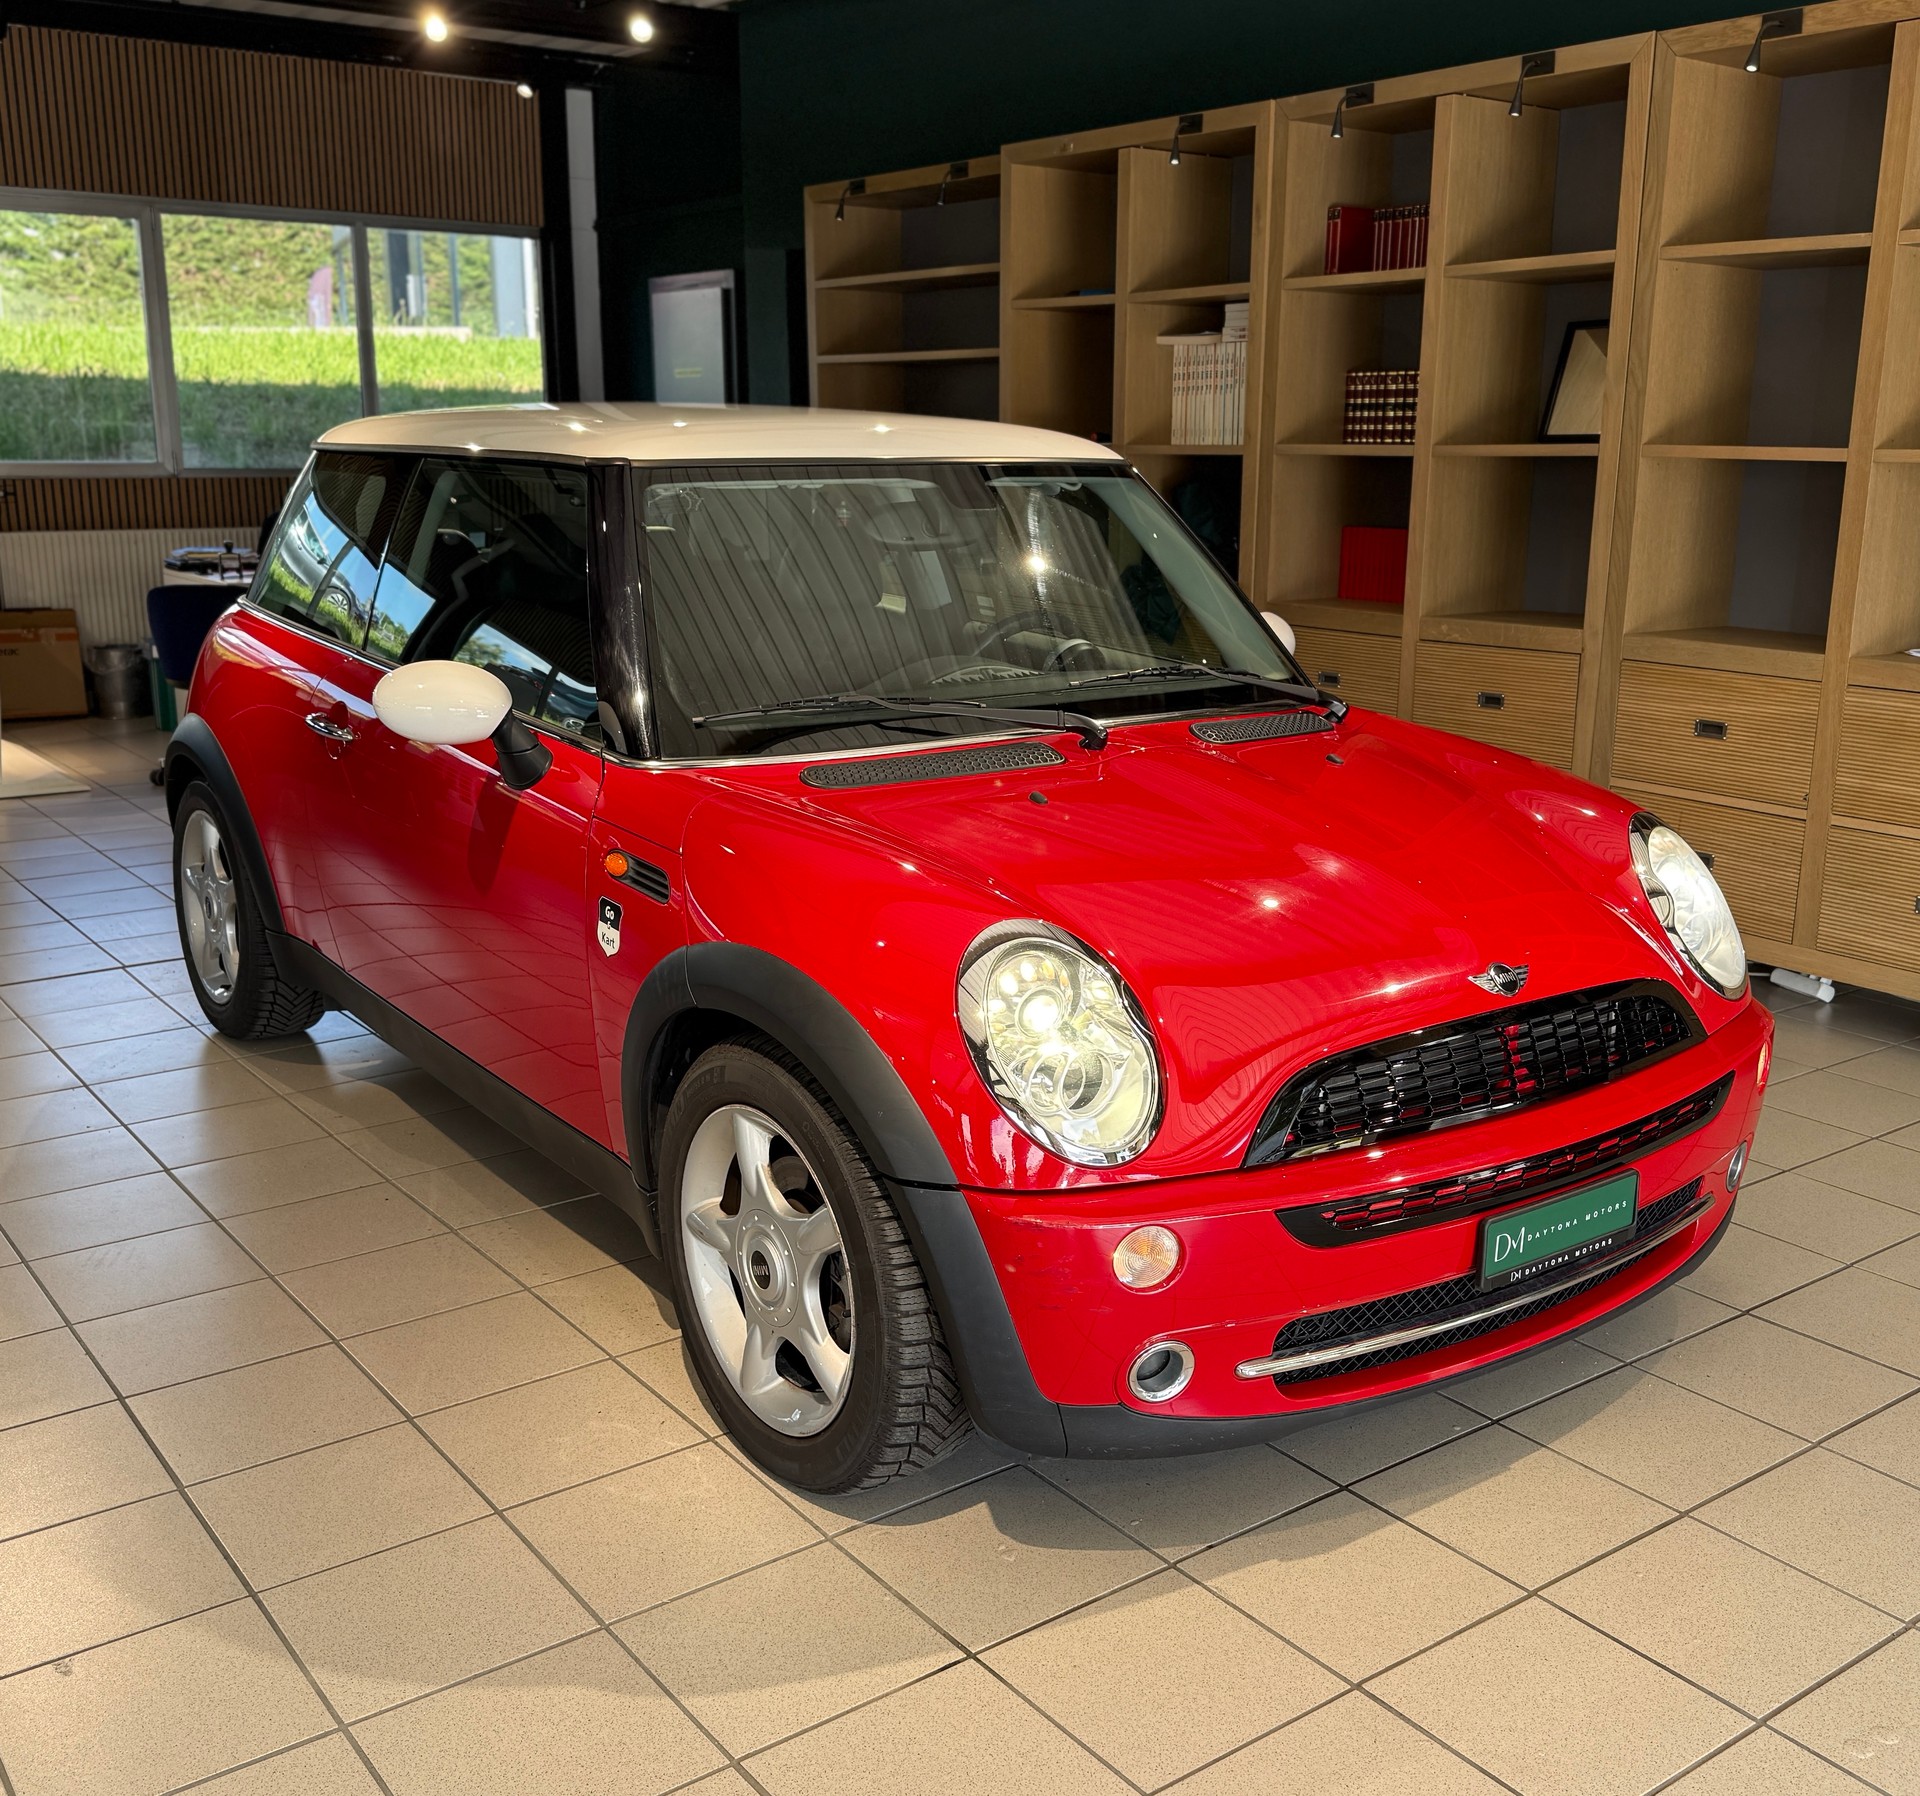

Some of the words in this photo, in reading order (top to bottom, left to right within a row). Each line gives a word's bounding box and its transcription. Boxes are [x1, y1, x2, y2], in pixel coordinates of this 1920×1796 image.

[605, 906, 615, 920] Go
[601, 932, 615, 949] Kart
[1494, 971, 1516, 985] MINI
[1527, 1218, 1578, 1242] DAYTONA
[1585, 1200, 1627, 1221] MOTORS
[1525, 1254, 1569, 1275] DAYTONA
[1575, 1237, 1613, 1257] MOTORS
